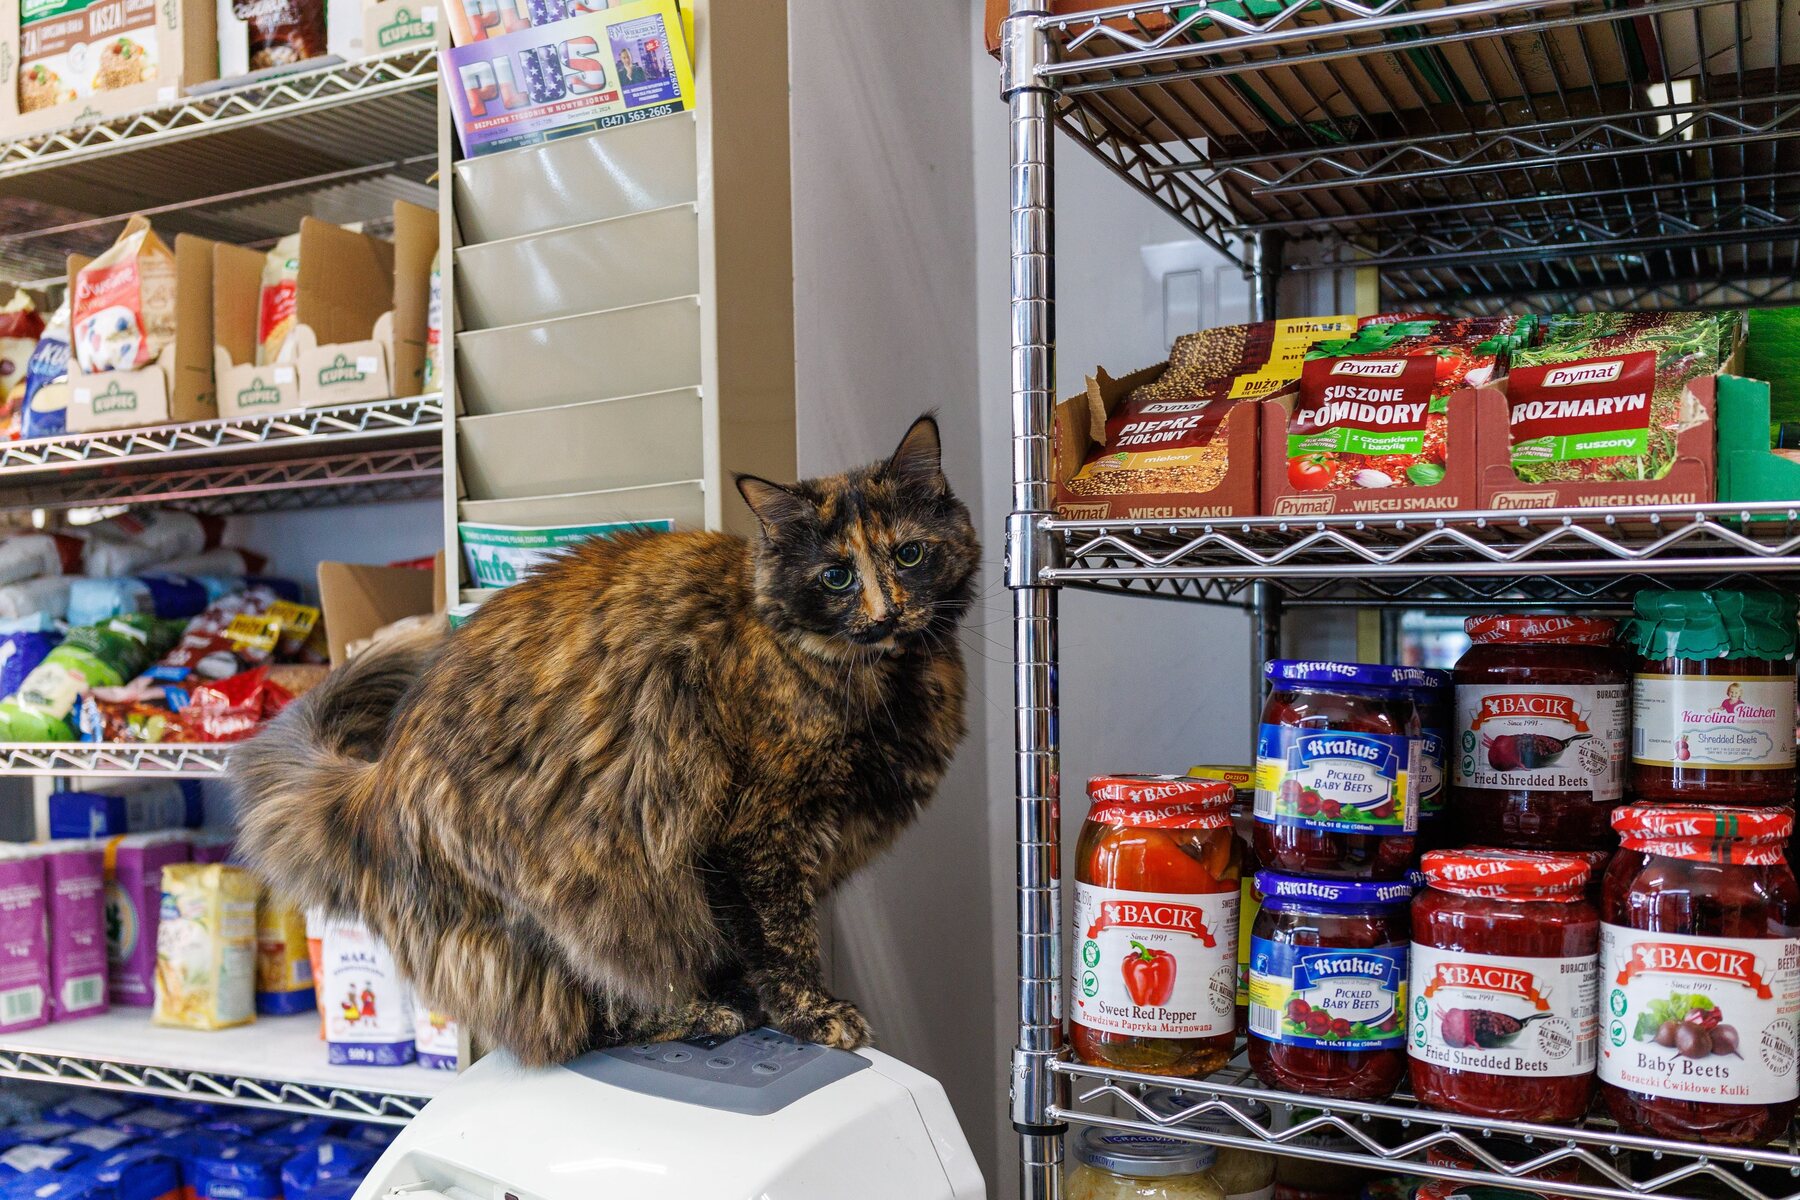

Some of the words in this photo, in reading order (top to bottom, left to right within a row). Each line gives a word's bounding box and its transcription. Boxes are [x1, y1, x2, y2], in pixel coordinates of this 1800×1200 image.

[382, 23, 433, 45] KUPIEC
[458, 35, 607, 117] PLUS
[555, 100, 583, 113] NOWYM
[585, 94, 610, 107] JORKU
[601, 114, 626, 130] (347)
[628, 104, 673, 122] 563-2605
[1339, 361, 1400, 376] Prymat
[1551, 364, 1616, 385] Prymat
[1245, 379, 1279, 392] DUŻO
[1323, 385, 1404, 403] SUSZONE
[94, 396, 135, 412] KUPIEC
[1148, 402, 1203, 412] Prymat
[1511, 393, 1647, 425] ROZMARYN
[1297, 402, 1427, 427] POMIDORY
[1118, 415, 1204, 436] PIEPRZ
[1116, 430, 1188, 447] ZIOŁOWY
[1360, 436, 1418, 444] czosnkiem
[1368, 442, 1405, 451] bazylią
[1576, 438, 1637, 450] suszony
[1144, 454, 1192, 463] mielony
[1280, 500, 1329, 516] Prymat
[1403, 496, 1458, 510] SMAKU
[1500, 496, 1549, 509] Prymat
[1635, 493, 1696, 506] SMAKU
[1058, 505, 1105, 520] Prymat
[1179, 506, 1233, 518] SMAKU
[471, 548, 517, 582] info
[1531, 616, 1575, 636] BACIK
[1296, 661, 1360, 677] Krakus
[1502, 698, 1568, 715] BACIK
[1681, 710, 1735, 724] Karolina
[1736, 706, 1776, 718] Kitchen
[1698, 734, 1735, 744] Shredded
[1737, 734, 1758, 744] Beets
[1307, 739, 1380, 760] Krakus
[1326, 769, 1365, 782] PICKLED
[1474, 772, 1498, 785] Fried
[1501, 773, 1555, 787] Shredded
[1558, 775, 1588, 787] Beets
[1144, 781, 1197, 802] BACIK
[1313, 779, 1342, 790] BABY
[1343, 781, 1373, 793] BEETS
[1145, 802, 1193, 823] BACIK
[1305, 819, 1317, 827] Net
[1455, 861, 1513, 881] BACIK
[1276, 881, 1340, 900] Krakus
[1123, 905, 1197, 928] BACIK
[1130, 932, 1148, 941] Since
[1150, 933, 1167, 942] 1991
[1314, 957, 1383, 976] Krakus
[1560, 960, 1588, 974] BURACZKI
[1659, 947, 1749, 977] BACIK
[1777, 957, 1796, 971] BEETS
[1209, 981, 1218, 992] ALL
[1457, 967, 1528, 992] BACIK
[1671, 981, 1691, 990] Since
[1693, 982, 1712, 991] 1991
[1335, 988, 1372, 998] PICKLED
[1479, 993, 1494, 1002] 1991
[1099, 1000, 1129, 1017] Sweet
[1132, 1006, 1155, 1020] Red
[1159, 1008, 1197, 1024] Pepper
[1322, 998, 1349, 1008] BABY
[1352, 999, 1379, 1009] BEETS
[1082, 1010, 1119, 1028] Prawdziwa
[1122, 1020, 1157, 1033] Papryka
[1160, 1023, 1213, 1034] Marynowana
[1539, 1029, 1549, 1039] ALL
[1550, 1032, 1572, 1047] NATURAL
[1761, 1035, 1774, 1048] ALL
[1774, 1039, 1795, 1059] NATURAL
[1426, 1045, 1450, 1062] Fried
[1453, 1051, 1510, 1070] Shredded
[1515, 1058, 1548, 1071] Beets
[1637, 1053, 1676, 1077] Baby
[1682, 1060, 1730, 1079] Beets
[1620, 1070, 1660, 1088] Buraczki
[1663, 1077, 1716, 1094] Ćwikłowe
[1720, 1085, 1749, 1096] Kulki
[1112, 1135, 1176, 1143] CRACOVIA
[1088, 1155, 1116, 1169] CRACOVIA
